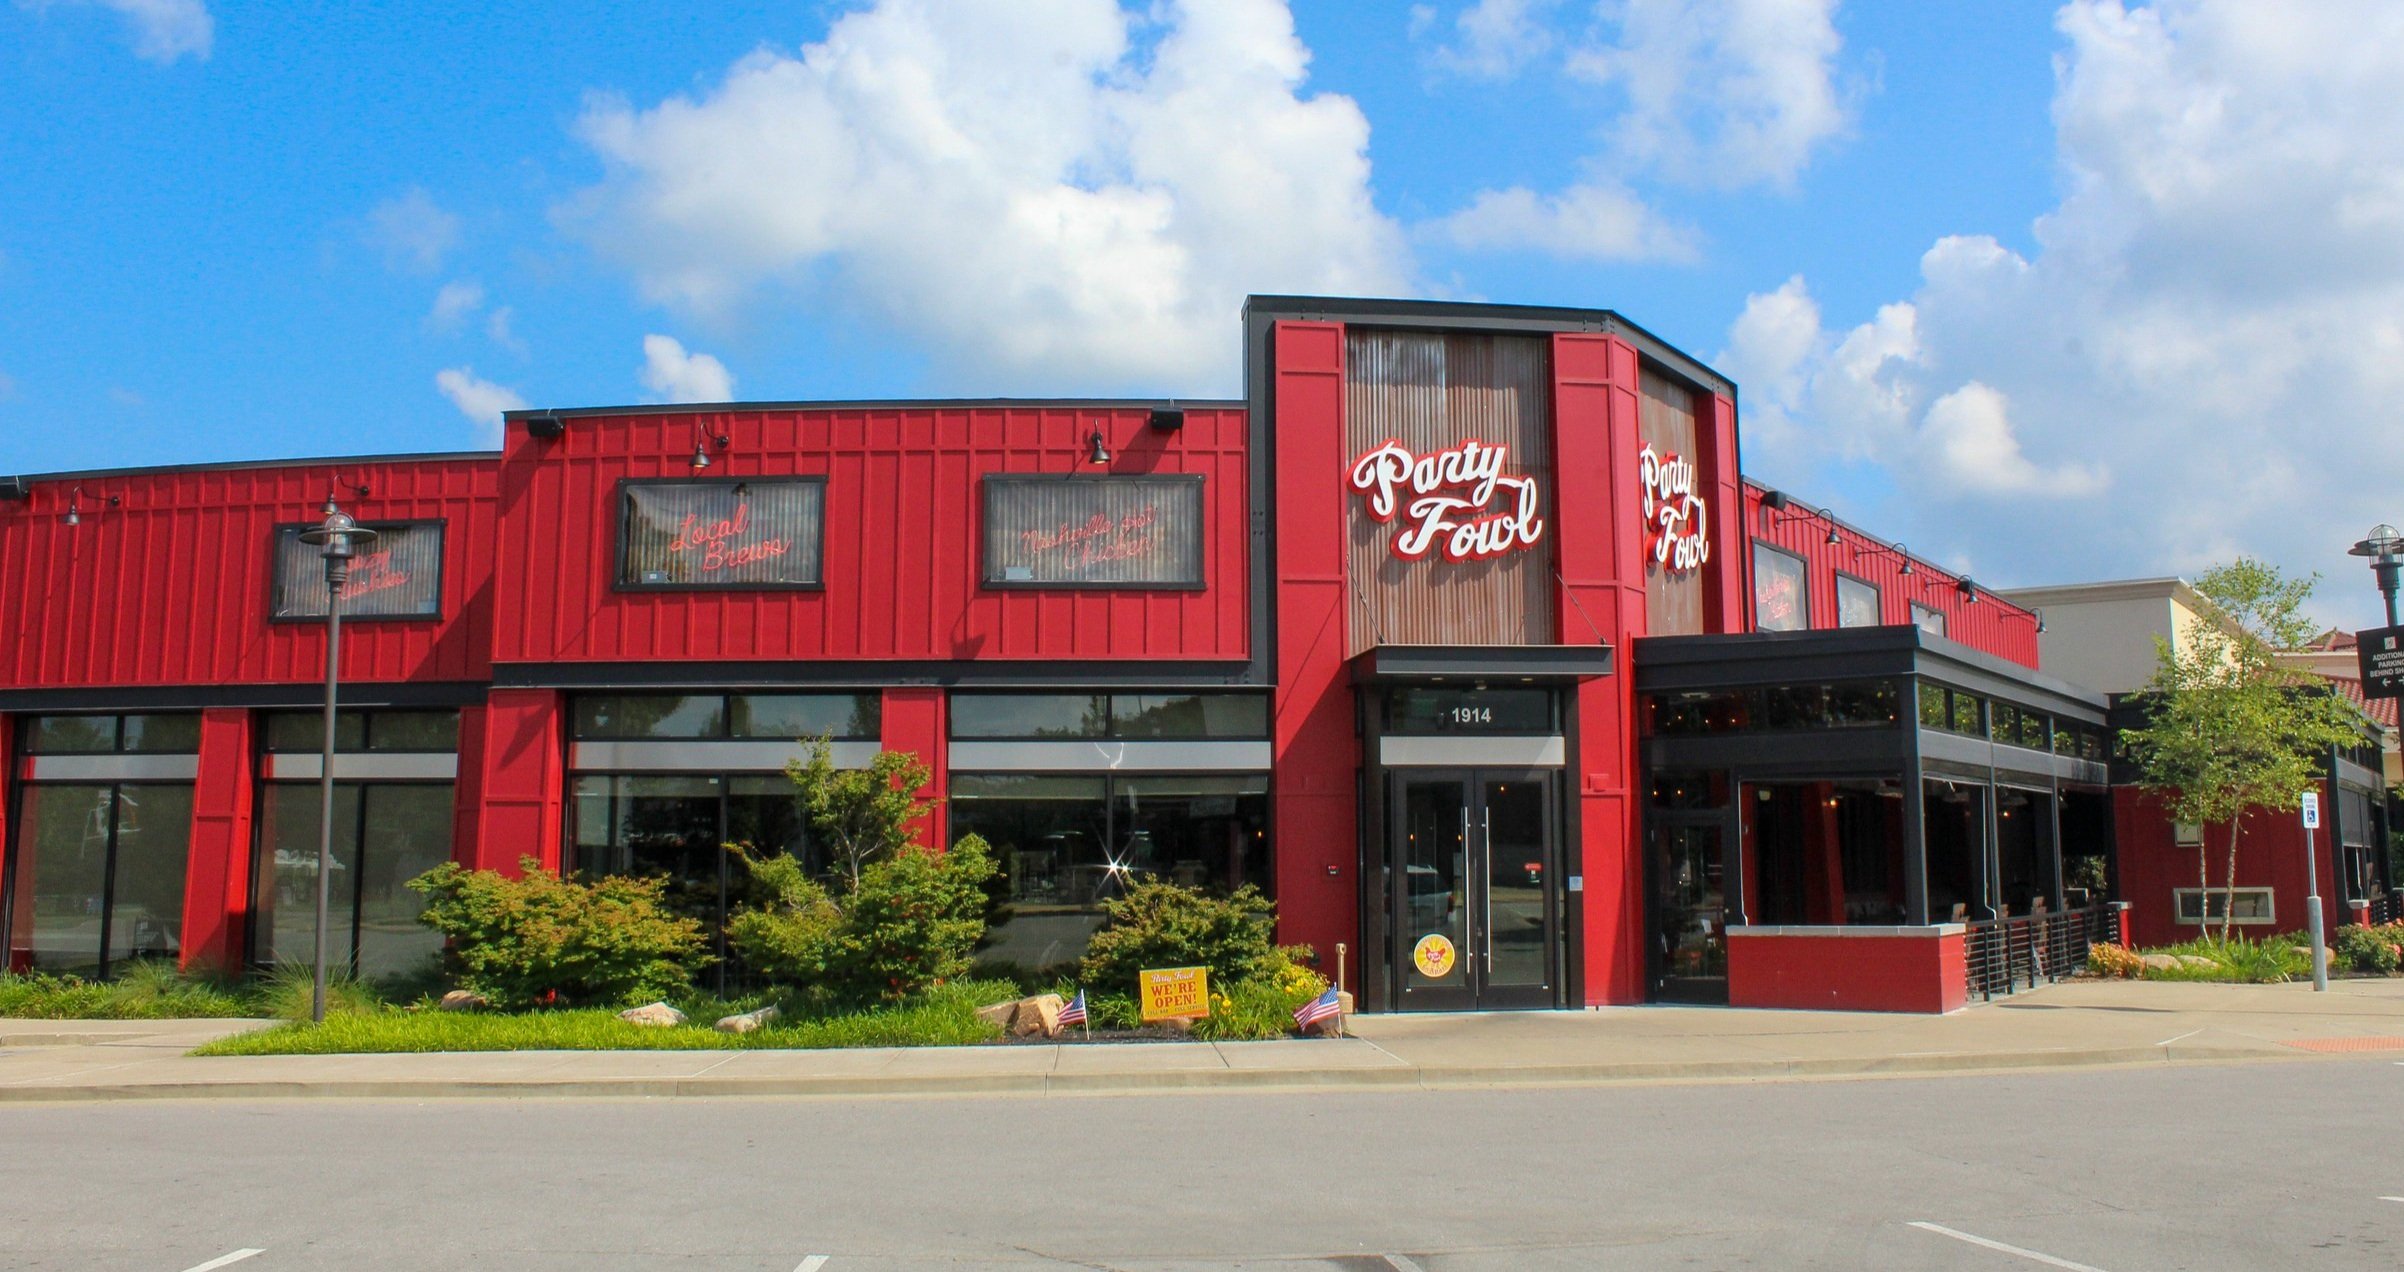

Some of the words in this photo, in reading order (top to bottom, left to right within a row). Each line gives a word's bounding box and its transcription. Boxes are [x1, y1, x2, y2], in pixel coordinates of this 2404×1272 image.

[1352, 441, 1507, 516] Party
[1640, 442, 1693, 519] Party
[670, 503, 749, 551] Local
[1022, 513, 1113, 554] Nashville
[1121, 502, 1157, 532] Hot
[1398, 477, 1543, 558] Fowl
[1656, 494, 1709, 570] Fowl
[703, 538, 791, 572] Brews
[1064, 530, 1156, 570] Chicken
[2370, 668, 2394, 678] BEHIND
[1452, 707, 1491, 723] 1914
[1151, 981, 1197, 997] WE'RE
[1152, 973, 1171, 983] Party
[1174, 971, 1194, 980] Fowl
[1155, 994, 1197, 1008] OPEN!
